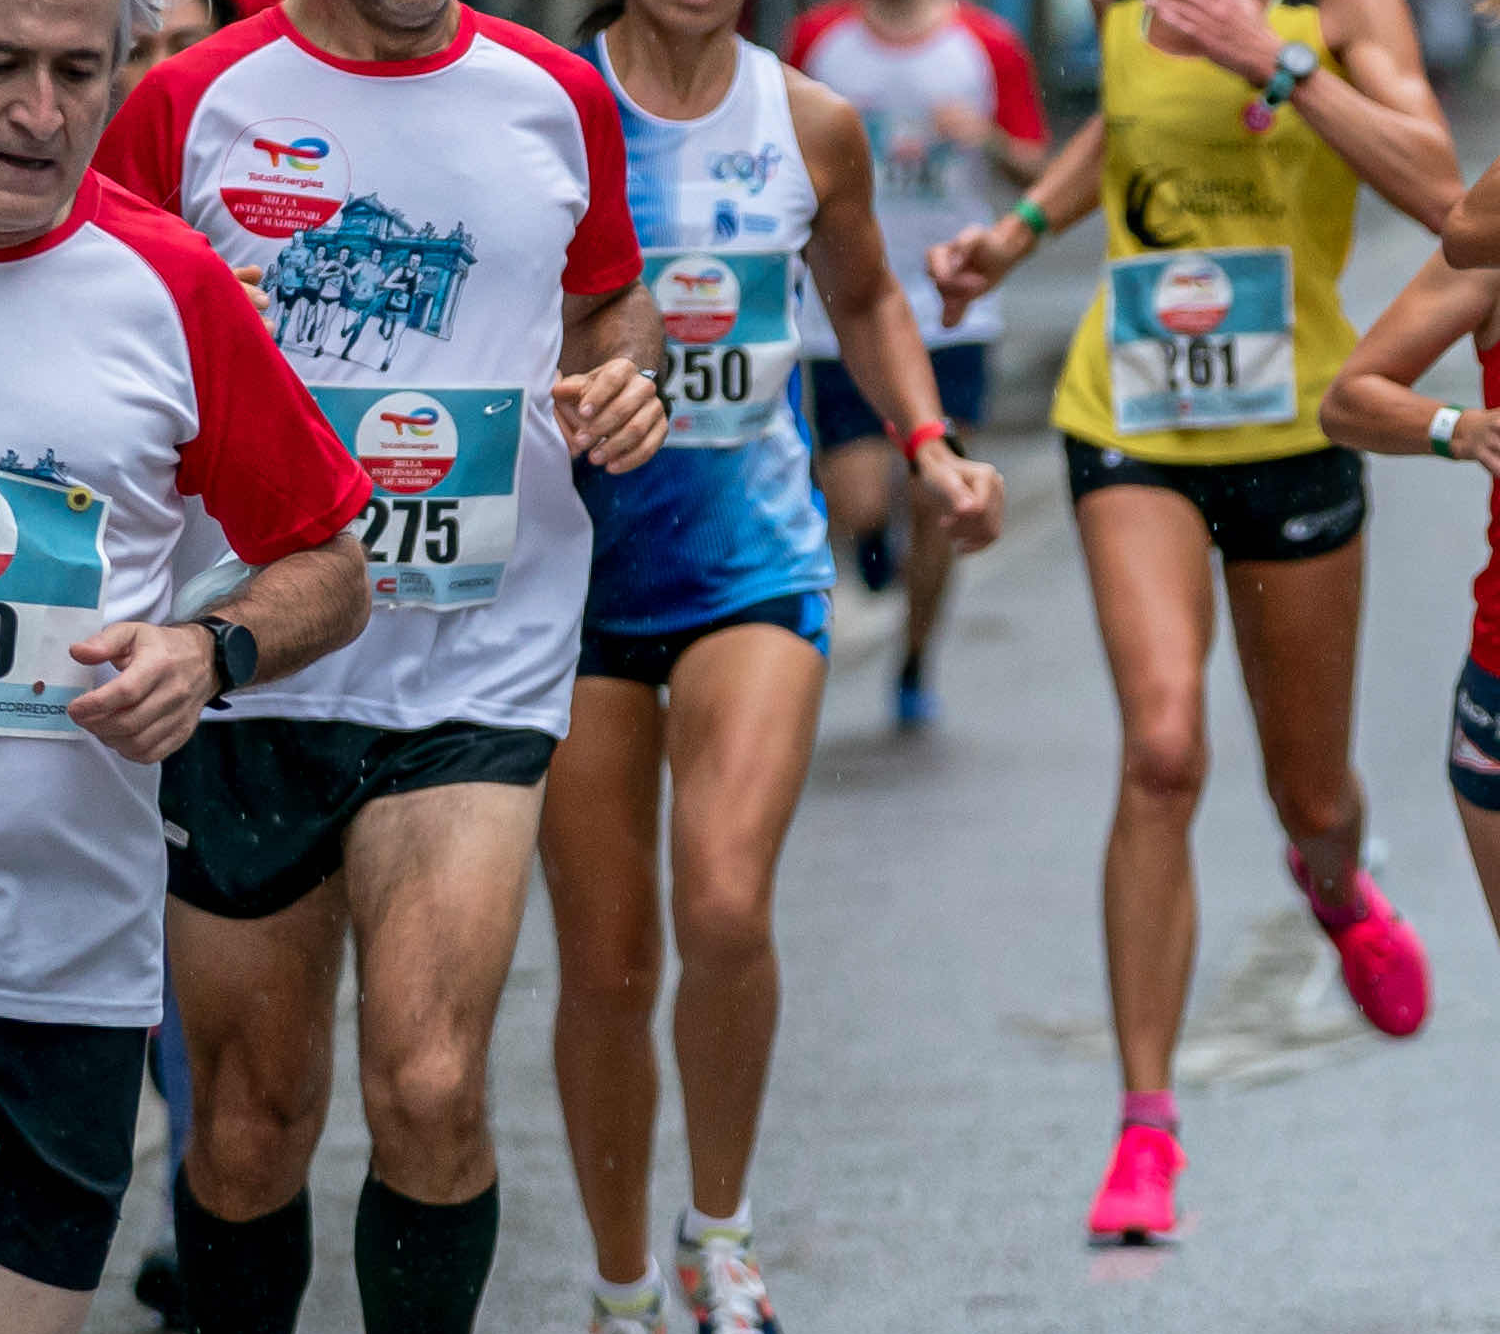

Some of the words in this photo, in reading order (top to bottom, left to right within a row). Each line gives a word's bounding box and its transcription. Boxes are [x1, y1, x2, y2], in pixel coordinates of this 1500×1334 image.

[248, 172, 324, 188] TotalEnergies
[261, 195, 298, 207] MILLA
[358, 497, 460, 565] 275
